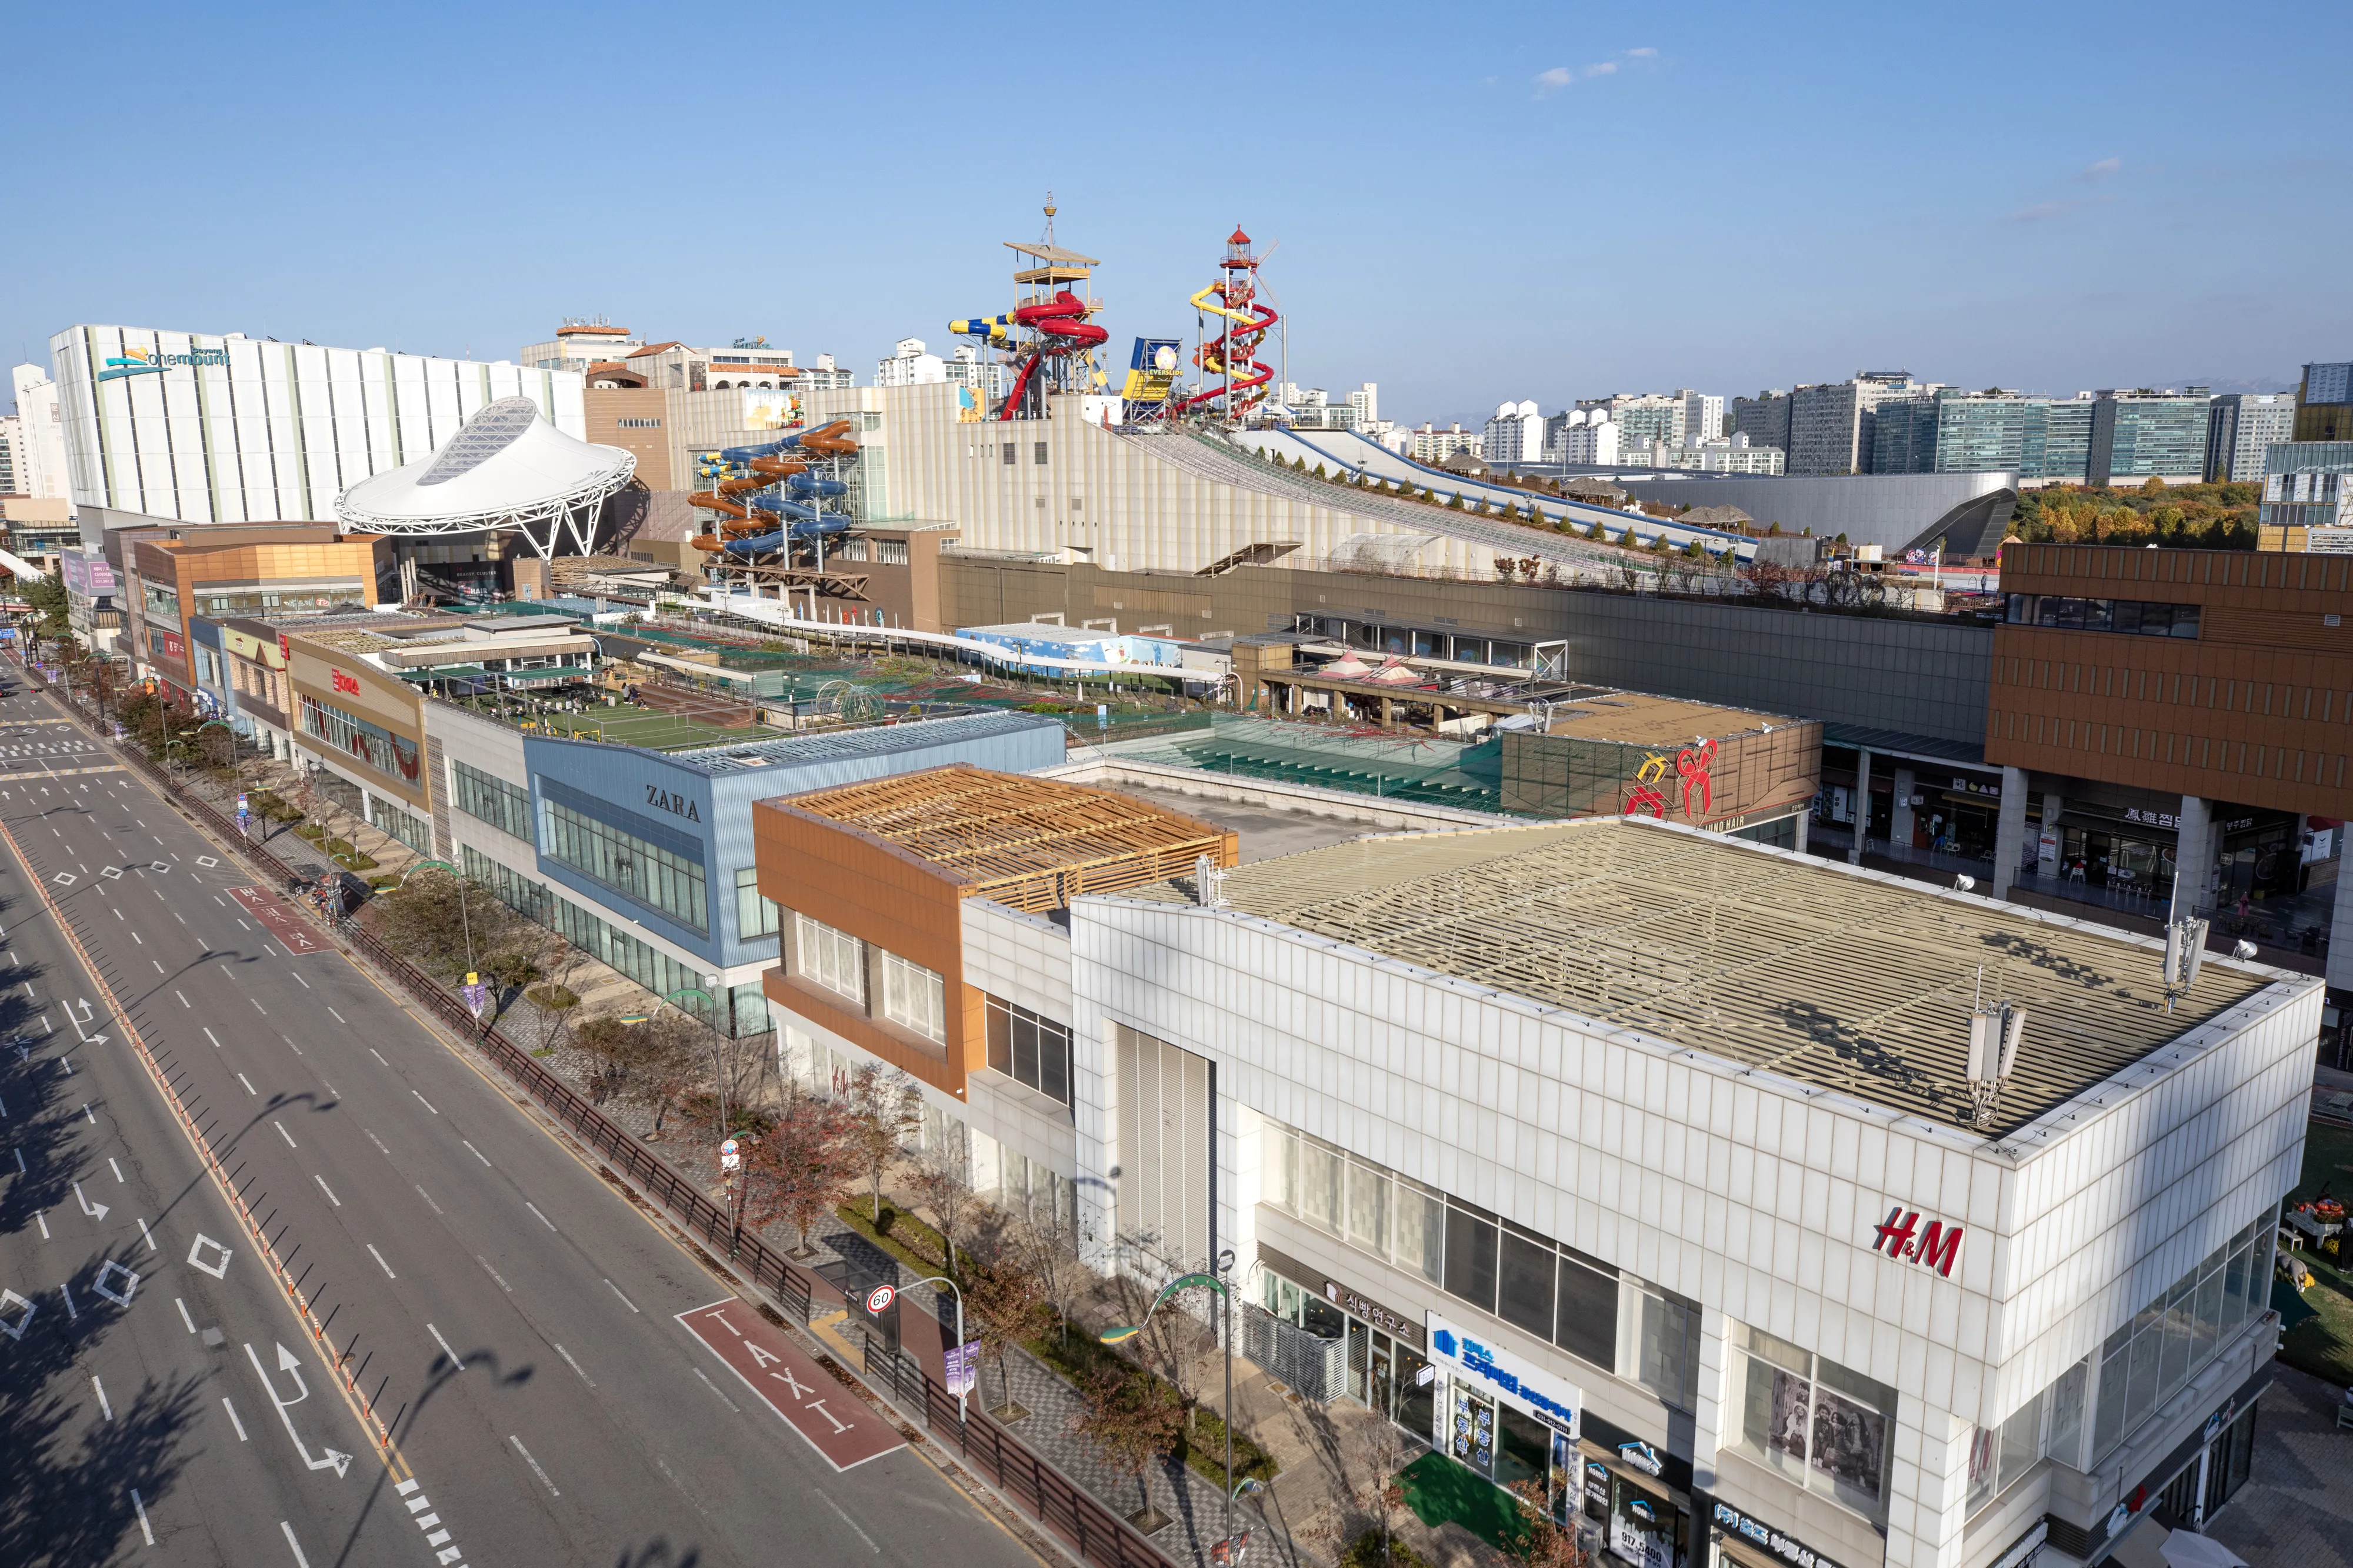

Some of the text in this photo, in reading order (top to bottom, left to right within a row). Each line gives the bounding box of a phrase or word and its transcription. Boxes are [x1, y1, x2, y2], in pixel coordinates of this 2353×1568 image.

[148, 353, 231, 365] onemount
[646, 784, 701, 823] ZARA
[1726, 810, 1745, 830] HAIR
[2227, 818, 2252, 831] 봉추찜닭
[1877, 1207, 1965, 1278] H&M
[874, 1292, 889, 1306] 60
[1347, 1294, 1411, 1338] 식빵연구소
[705, 1309, 855, 1434] TAXI
[1461, 1352, 1518, 1395] 프리미엄
[1518, 1384, 1572, 1423] 공인중개사
[1456, 1397, 1469, 1454] 부동산
[1477, 1408, 1491, 1466] 부동산
[1537, 1413, 1568, 1433] 031-912-0111
[1588, 1466, 1607, 1482] HOMES
[1621, 1447, 1659, 1477] HOMES
[1588, 1480, 1606, 1496] 부동산
[1632, 1503, 1655, 1523] HOMES
[1769, 1533, 1815, 1568] 부동산
